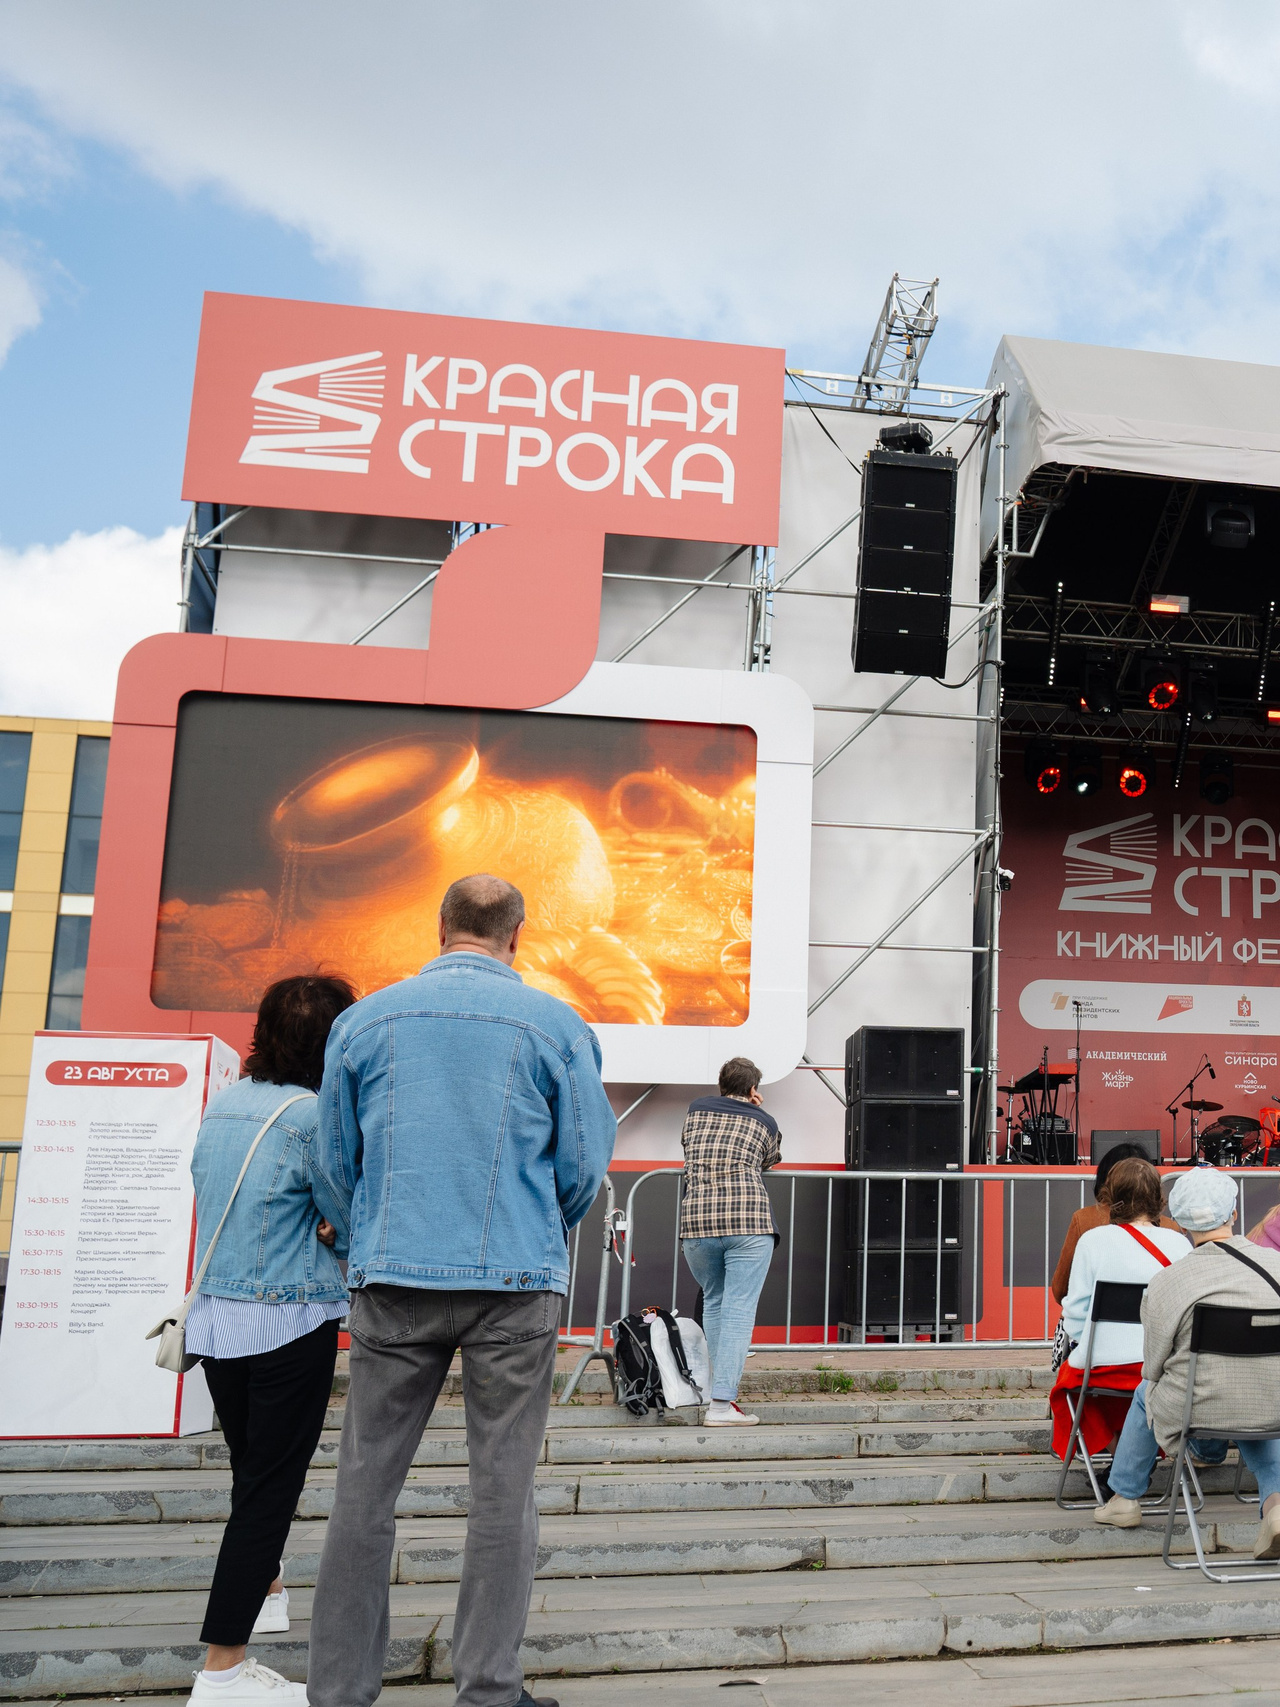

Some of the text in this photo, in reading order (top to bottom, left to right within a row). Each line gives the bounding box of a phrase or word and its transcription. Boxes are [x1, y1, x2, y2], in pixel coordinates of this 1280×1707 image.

[402, 353, 739, 436] КРАСНАЯ
[398, 418, 735, 505] СТРОКА
[1056, 930, 1222, 963] КНИЖНЫЙ
[1086, 1050, 1168, 1061] АКАДЕМИЧЕСКИЙ
[1224, 1056, 1278, 1068] синара
[64, 1066, 169, 1082] 23 АВГУСТА
[1102, 1070, 1134, 1082] Жизнь
[1105, 1081, 1131, 1090] март
